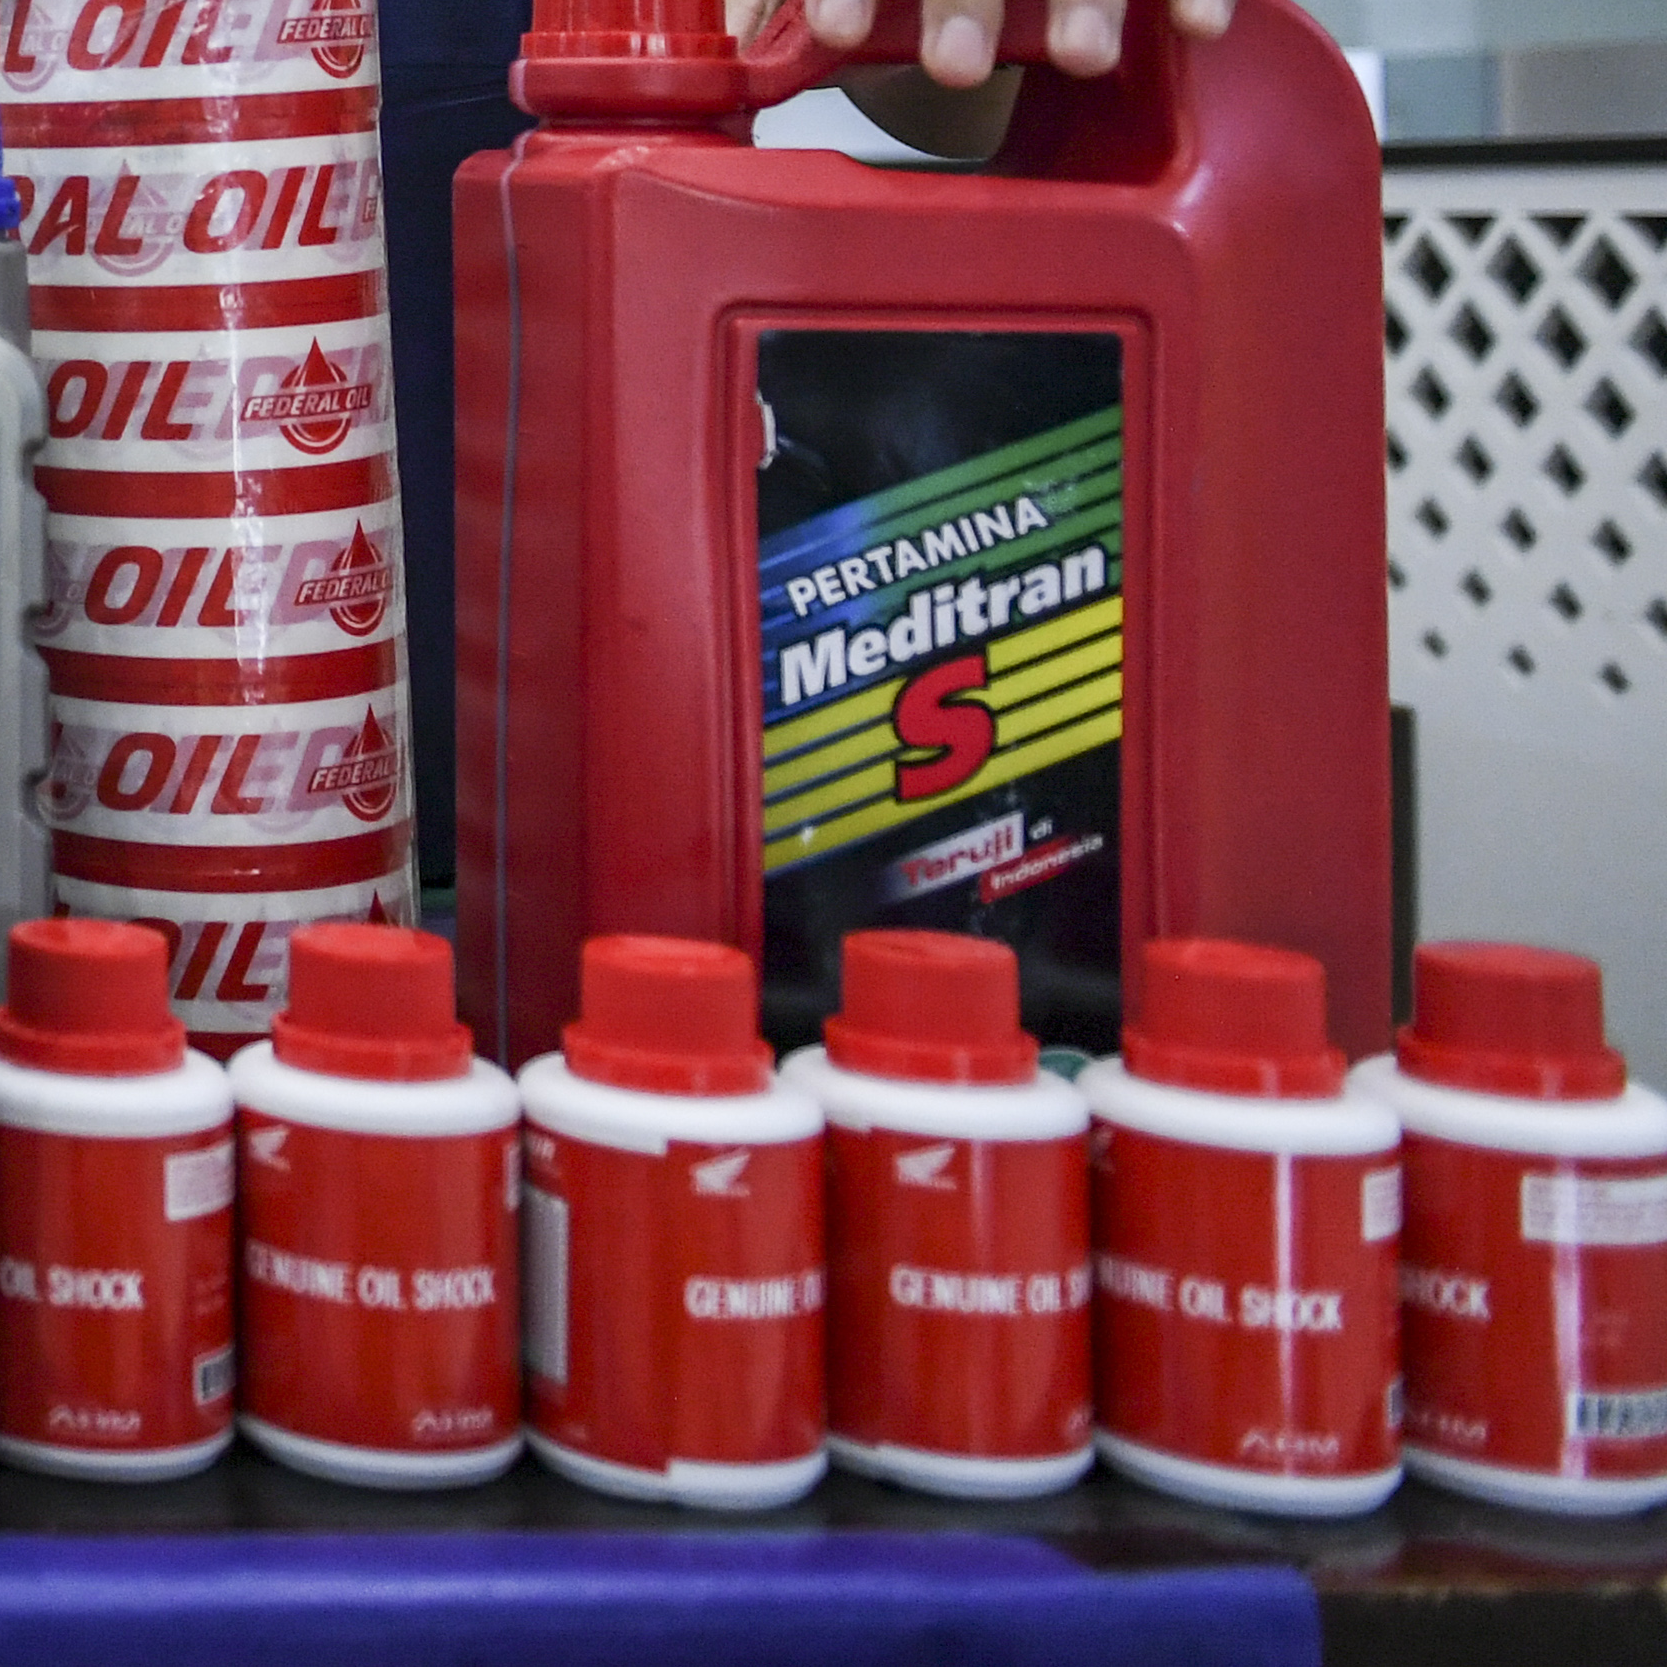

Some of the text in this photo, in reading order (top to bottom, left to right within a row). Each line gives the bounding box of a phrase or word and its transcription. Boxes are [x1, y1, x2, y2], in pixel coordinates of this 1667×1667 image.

[280, 15, 363, 42] FEDERAL
[183, 163, 341, 255] OIL
[48, 360, 196, 442] OIL
[244, 385, 343, 419] FEDERAL
[83, 544, 252, 629] OIL
[785, 497, 1049, 619] PERTAMINA
[298, 573, 378, 604] FEDERAL
[779, 544, 1107, 707] Meditran
[892, 651, 998, 805] S
[95, 731, 267, 815] OIL
[310, 758, 391, 793] FEDERAL
[47, 1263, 145, 1311] SHOCK
[357, 1265, 407, 1311] OIL
[411, 1265, 496, 1312] SHOCK
[684, 1274, 798, 1321] GENUINE
[888, 1262, 1023, 1317] GENUINE
[1025, 1270, 1065, 1316] OIL
[1179, 1272, 1232, 1324] OIL
[1239, 1282, 1343, 1332] SHOCK
